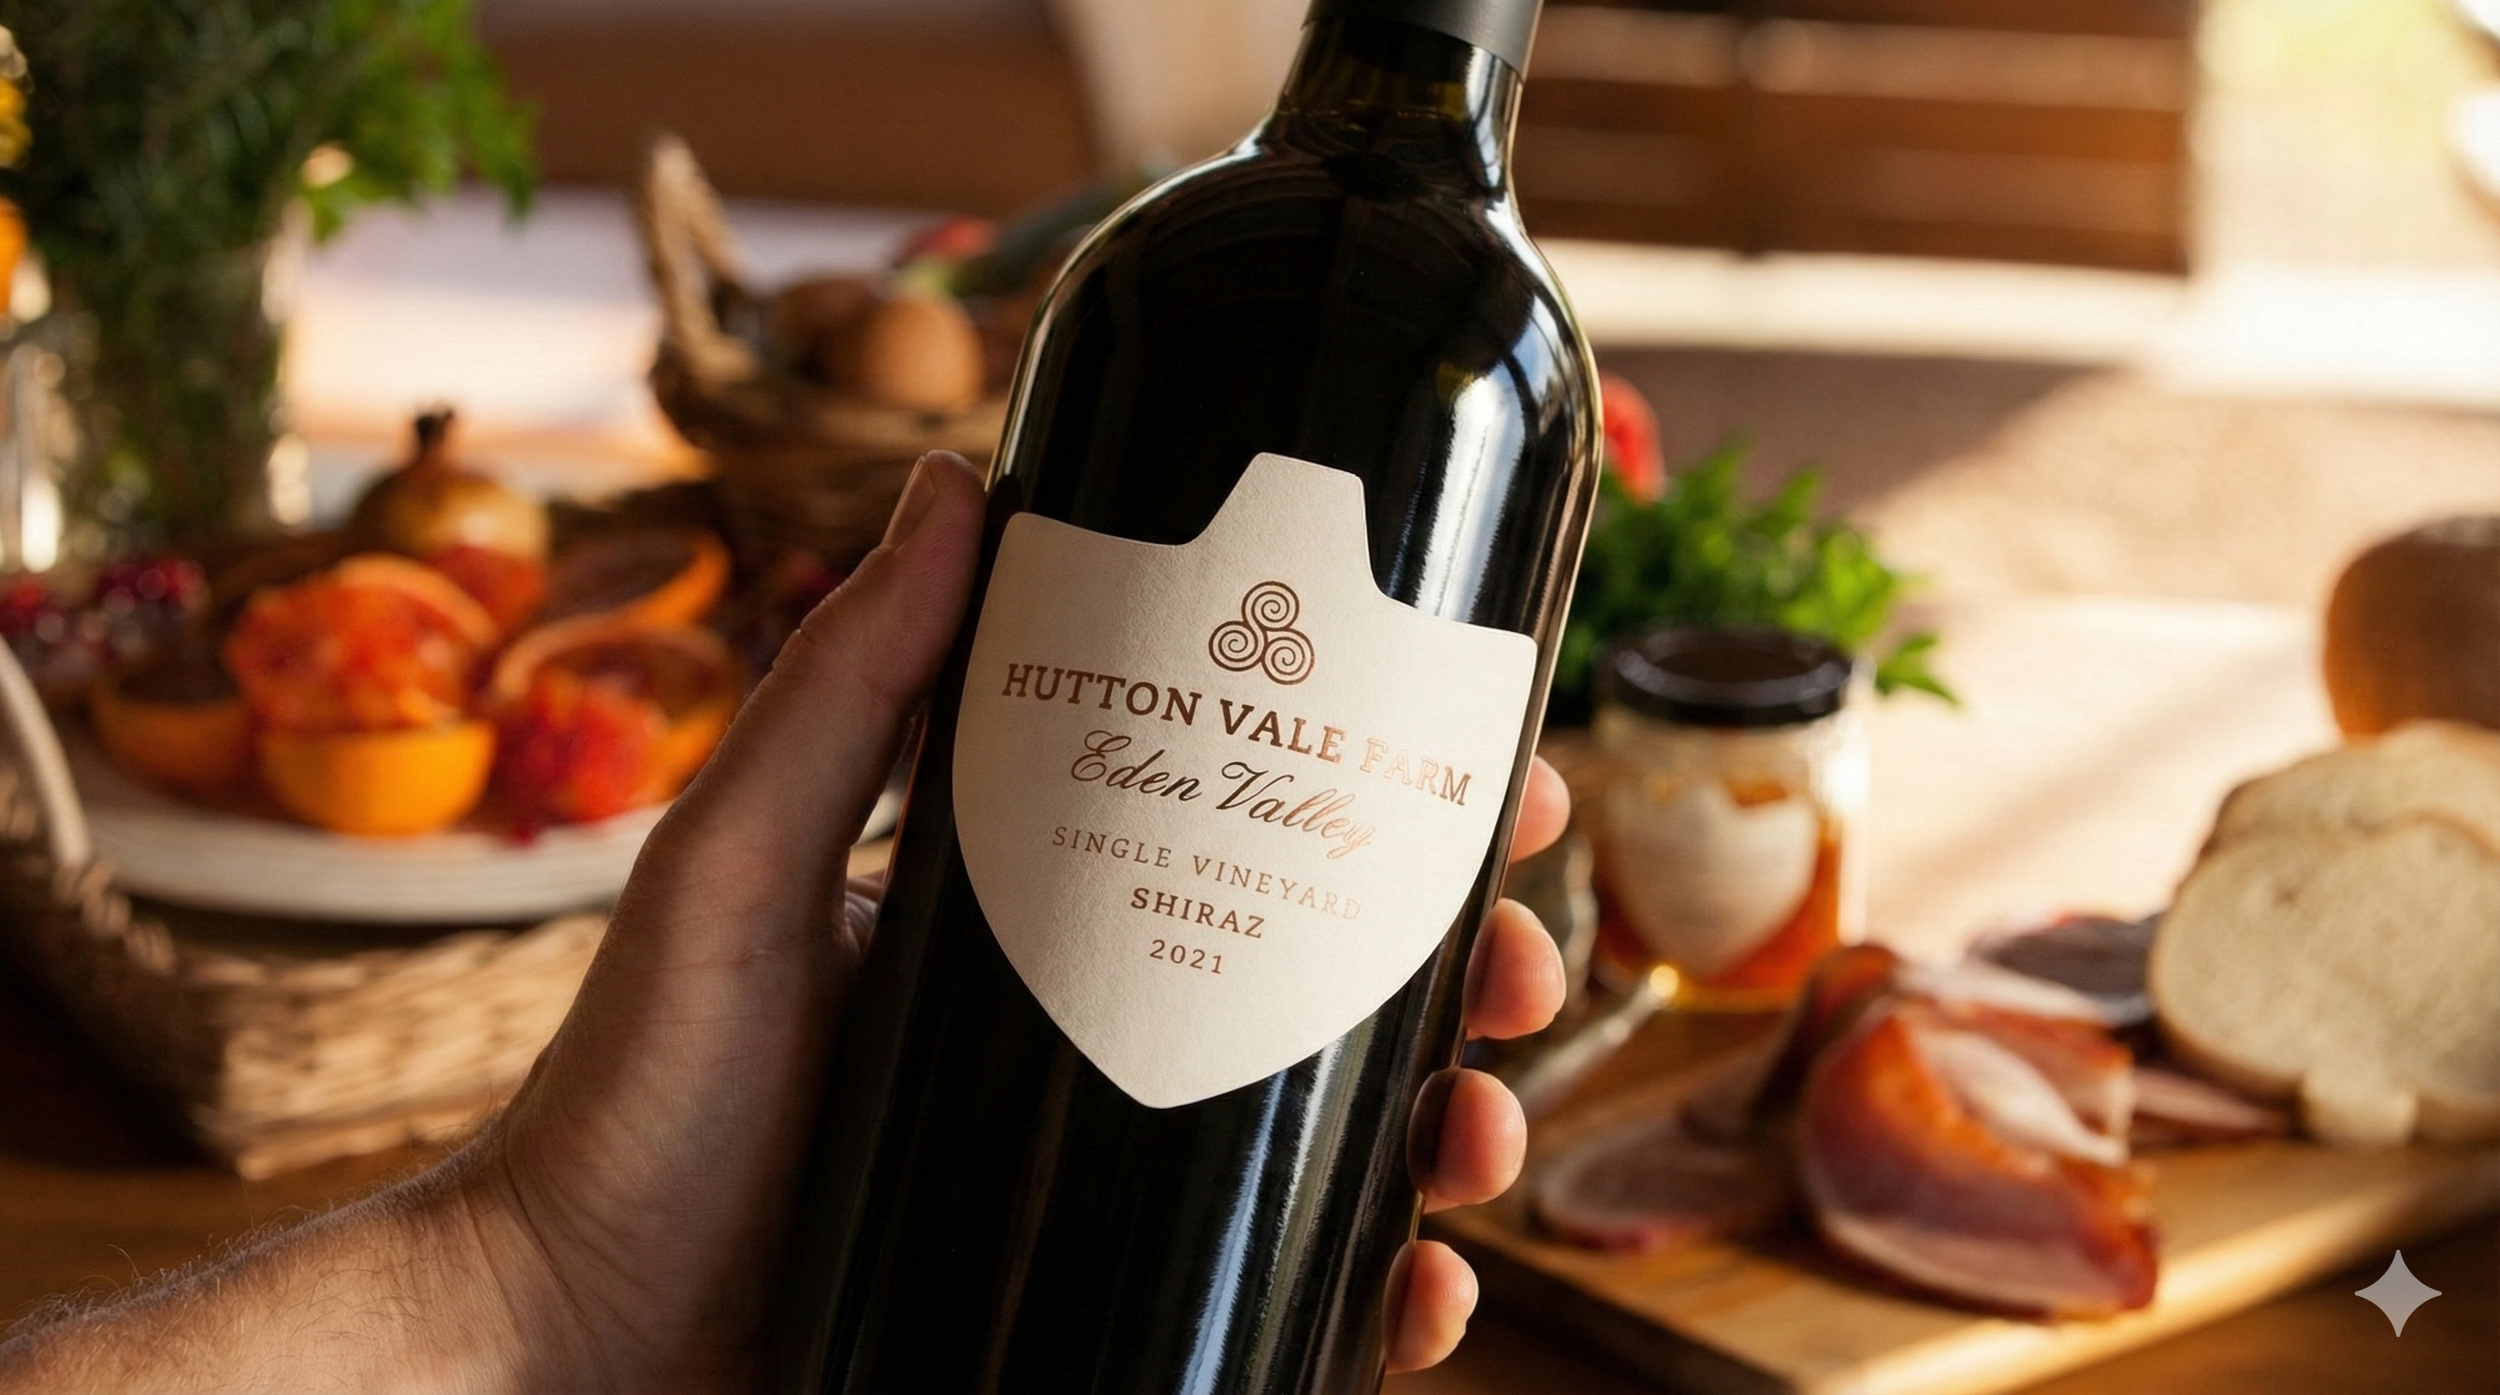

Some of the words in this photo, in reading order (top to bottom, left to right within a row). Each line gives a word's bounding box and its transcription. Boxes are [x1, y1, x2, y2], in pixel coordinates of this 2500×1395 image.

[1001, 662, 1202, 726] HUTTON
[1219, 698, 1346, 764] VALE
[1359, 736, 1473, 807] FARM
[1070, 729, 1203, 804] Eden
[1214, 760, 1377, 860] Valley
[1051, 825, 1173, 869] SINGLE
[1192, 854, 1362, 921] VINEYARD
[1130, 887, 1266, 939] SHIRAZ
[1148, 938, 1223, 976] 2021
